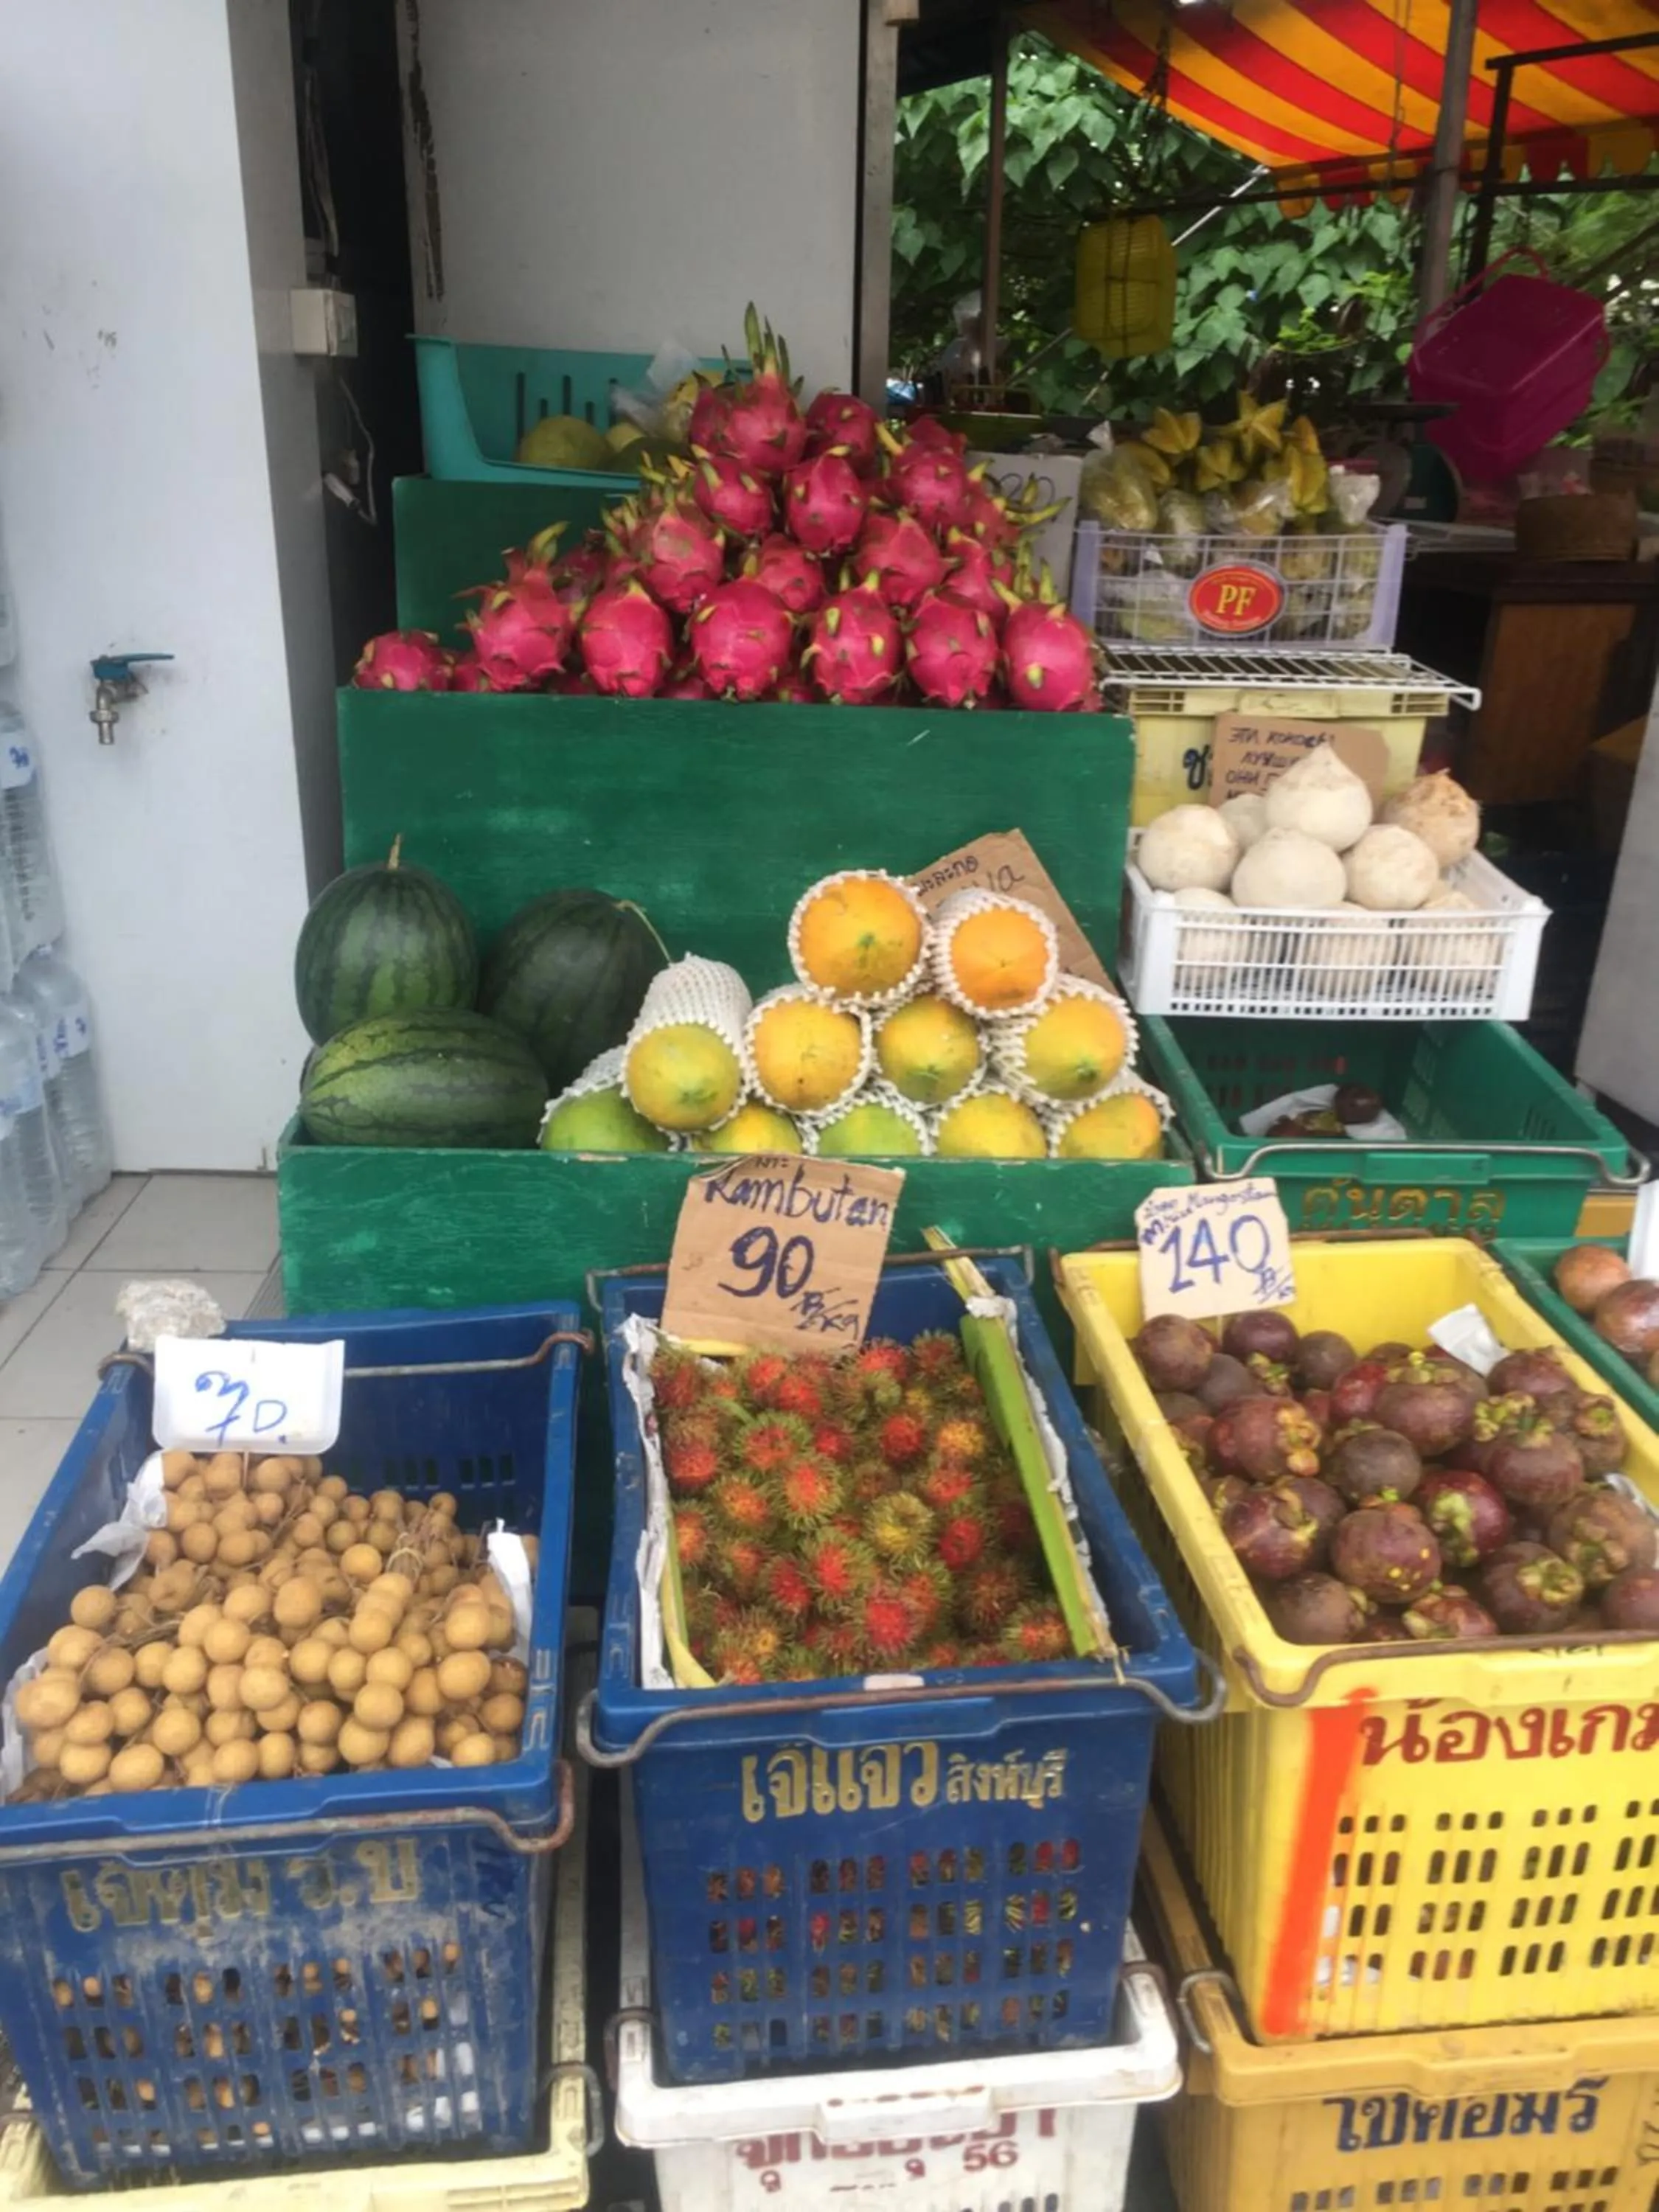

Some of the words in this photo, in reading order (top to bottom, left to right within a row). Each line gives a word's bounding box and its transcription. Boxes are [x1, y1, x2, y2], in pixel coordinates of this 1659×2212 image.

[1216, 584, 1256, 616] PF
[717, 1225, 815, 1299] 90
[1158, 1215, 1271, 1295] 140
[741, 1741, 939, 1824] เจแจว
[963, 2139, 1019, 2172] 56
